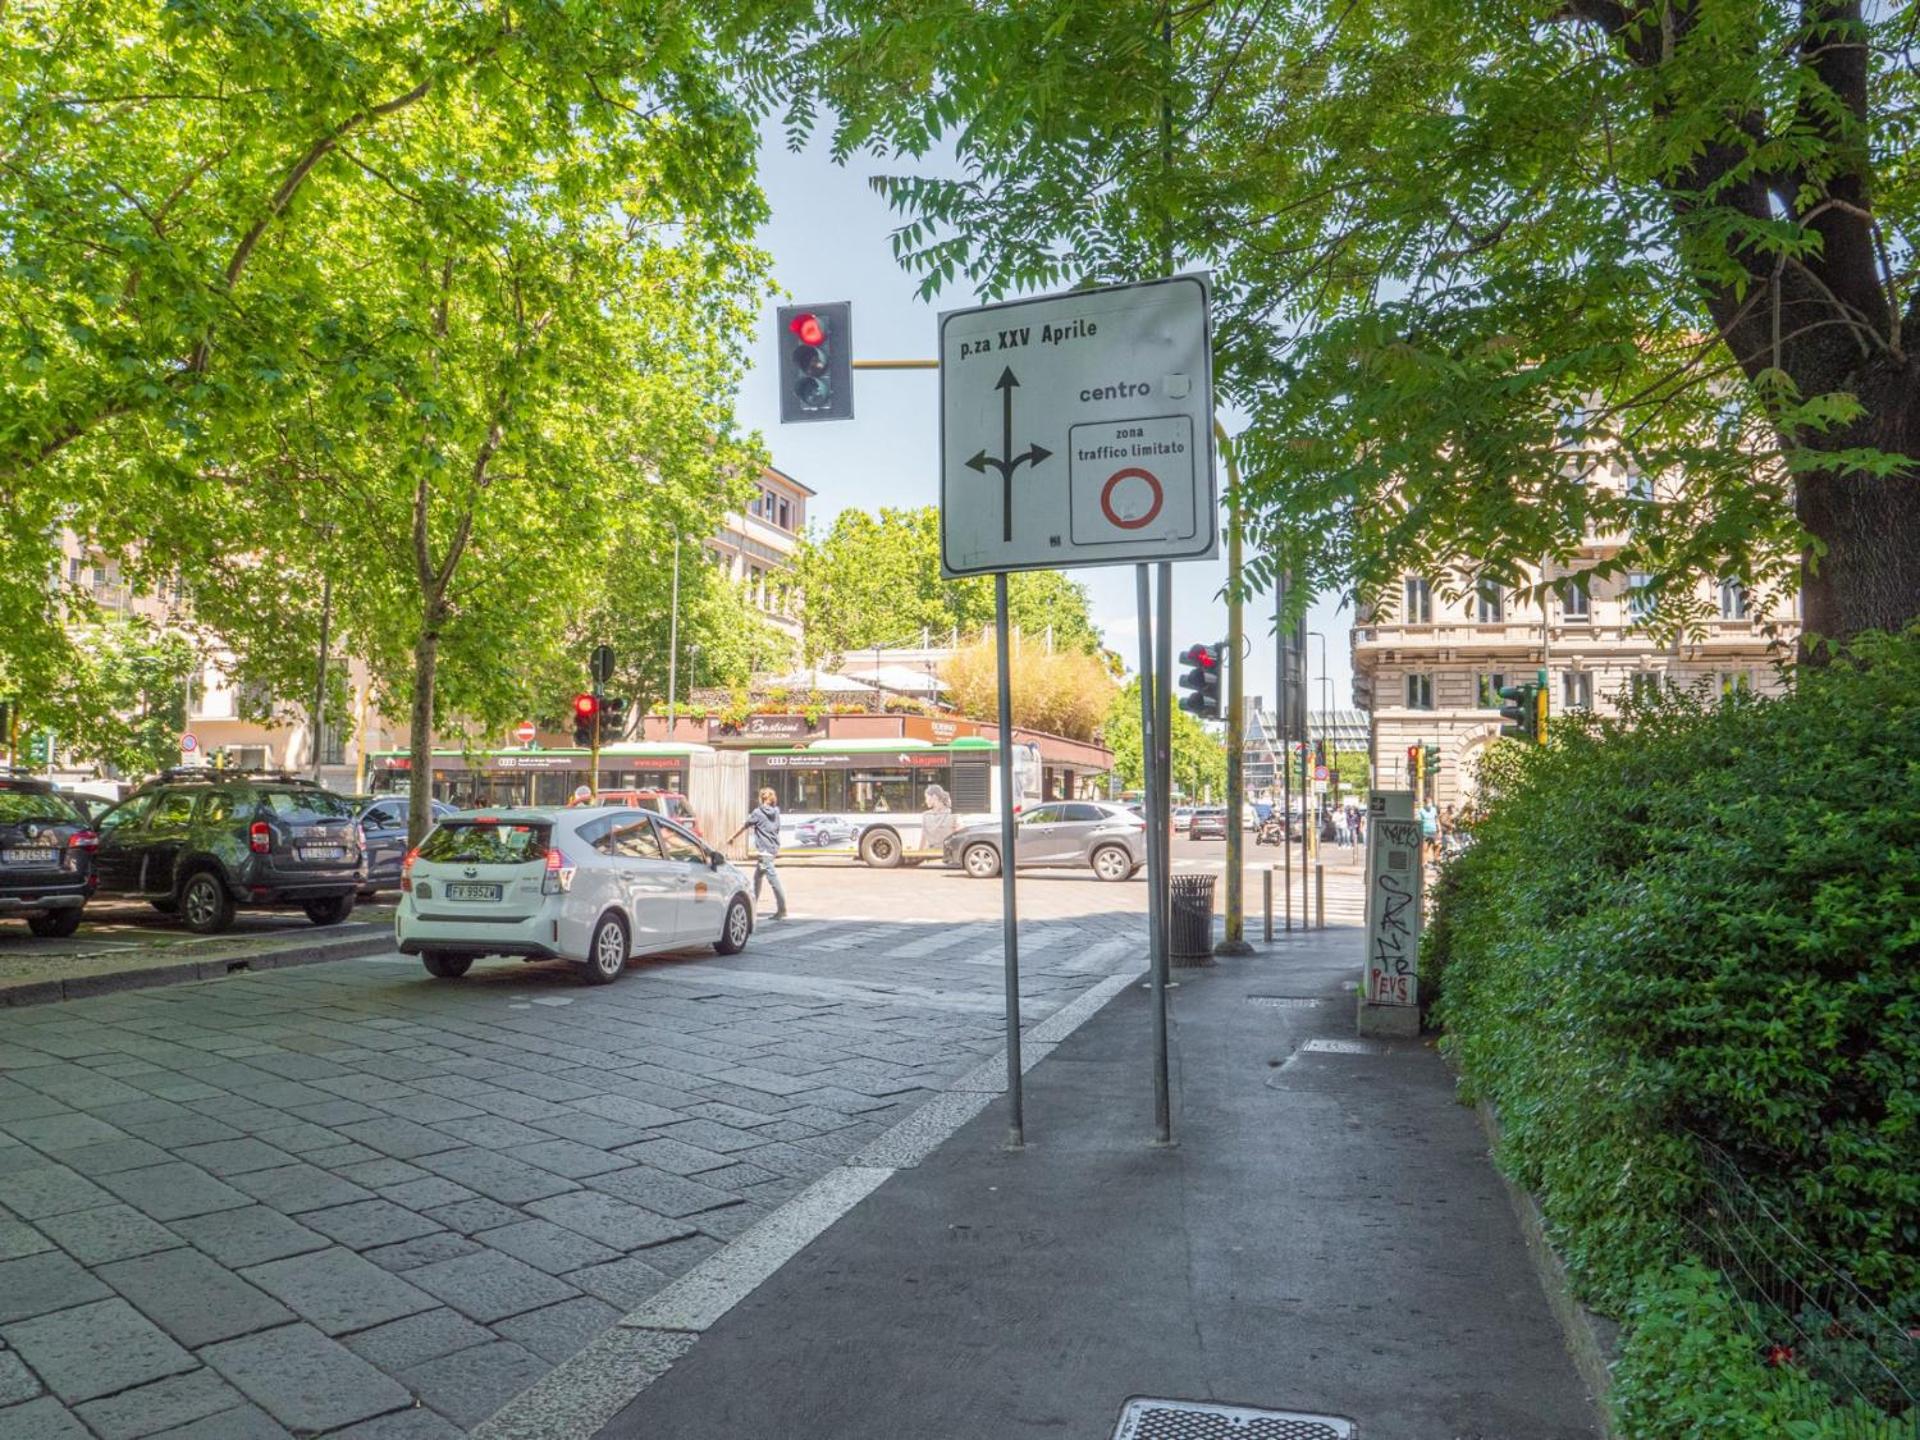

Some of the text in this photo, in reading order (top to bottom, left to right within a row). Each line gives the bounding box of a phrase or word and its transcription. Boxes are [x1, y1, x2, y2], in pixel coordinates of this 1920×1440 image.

[960, 319, 1097, 360] p.za XXV Aprile
[1080, 381, 1150, 402] centro
[1116, 428, 1144, 439] zona
[1078, 442, 1185, 461] traffico limitato
